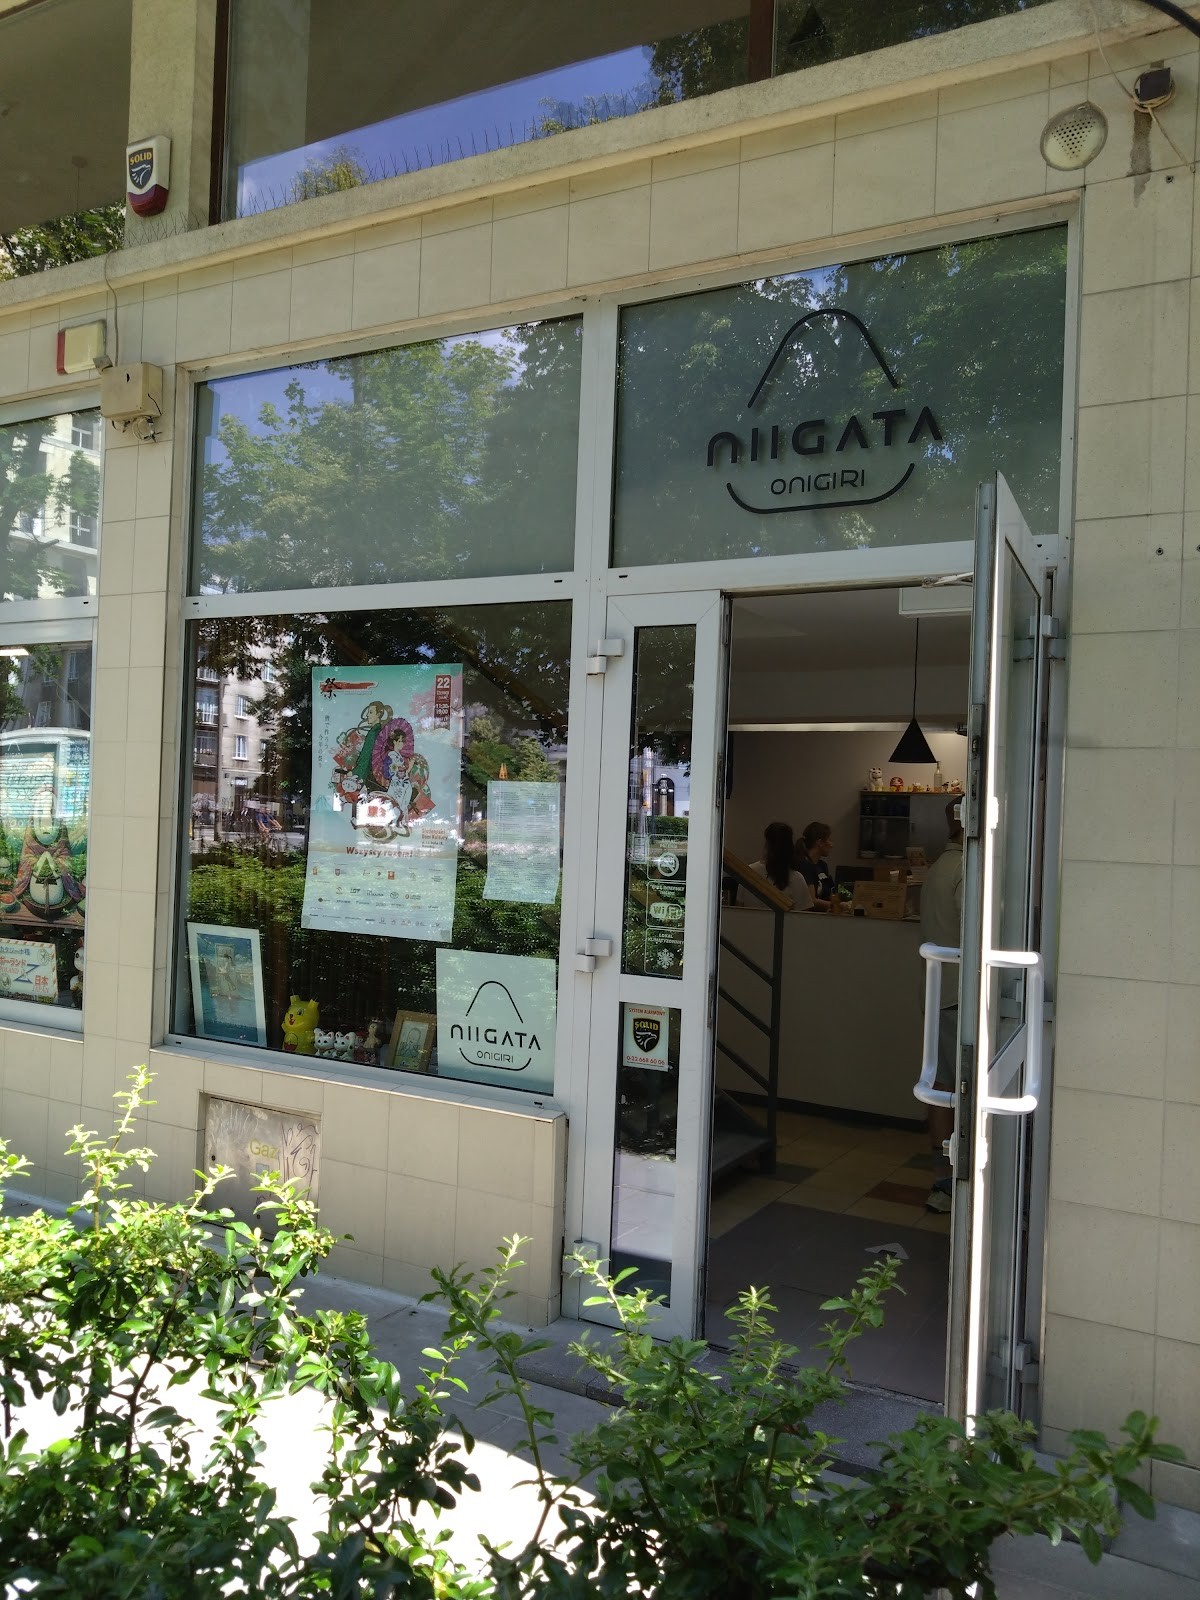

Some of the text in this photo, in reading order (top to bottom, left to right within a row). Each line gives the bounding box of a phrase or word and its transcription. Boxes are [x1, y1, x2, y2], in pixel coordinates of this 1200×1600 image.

[130, 152, 152, 165] SOLID
[707, 406, 943, 466] NIIGATA
[770, 469, 865, 495] ONIGIRI
[437, 677, 450, 689] 22
[346, 846, 381, 858] Wszyscy
[34, 974, 49, 986] 日本
[634, 1020, 659, 1031] SOLID
[450, 1024, 542, 1051] NIIGATA
[476, 1050, 515, 1063] ONIGIRI
[249, 1138, 279, 1160] Gaz
